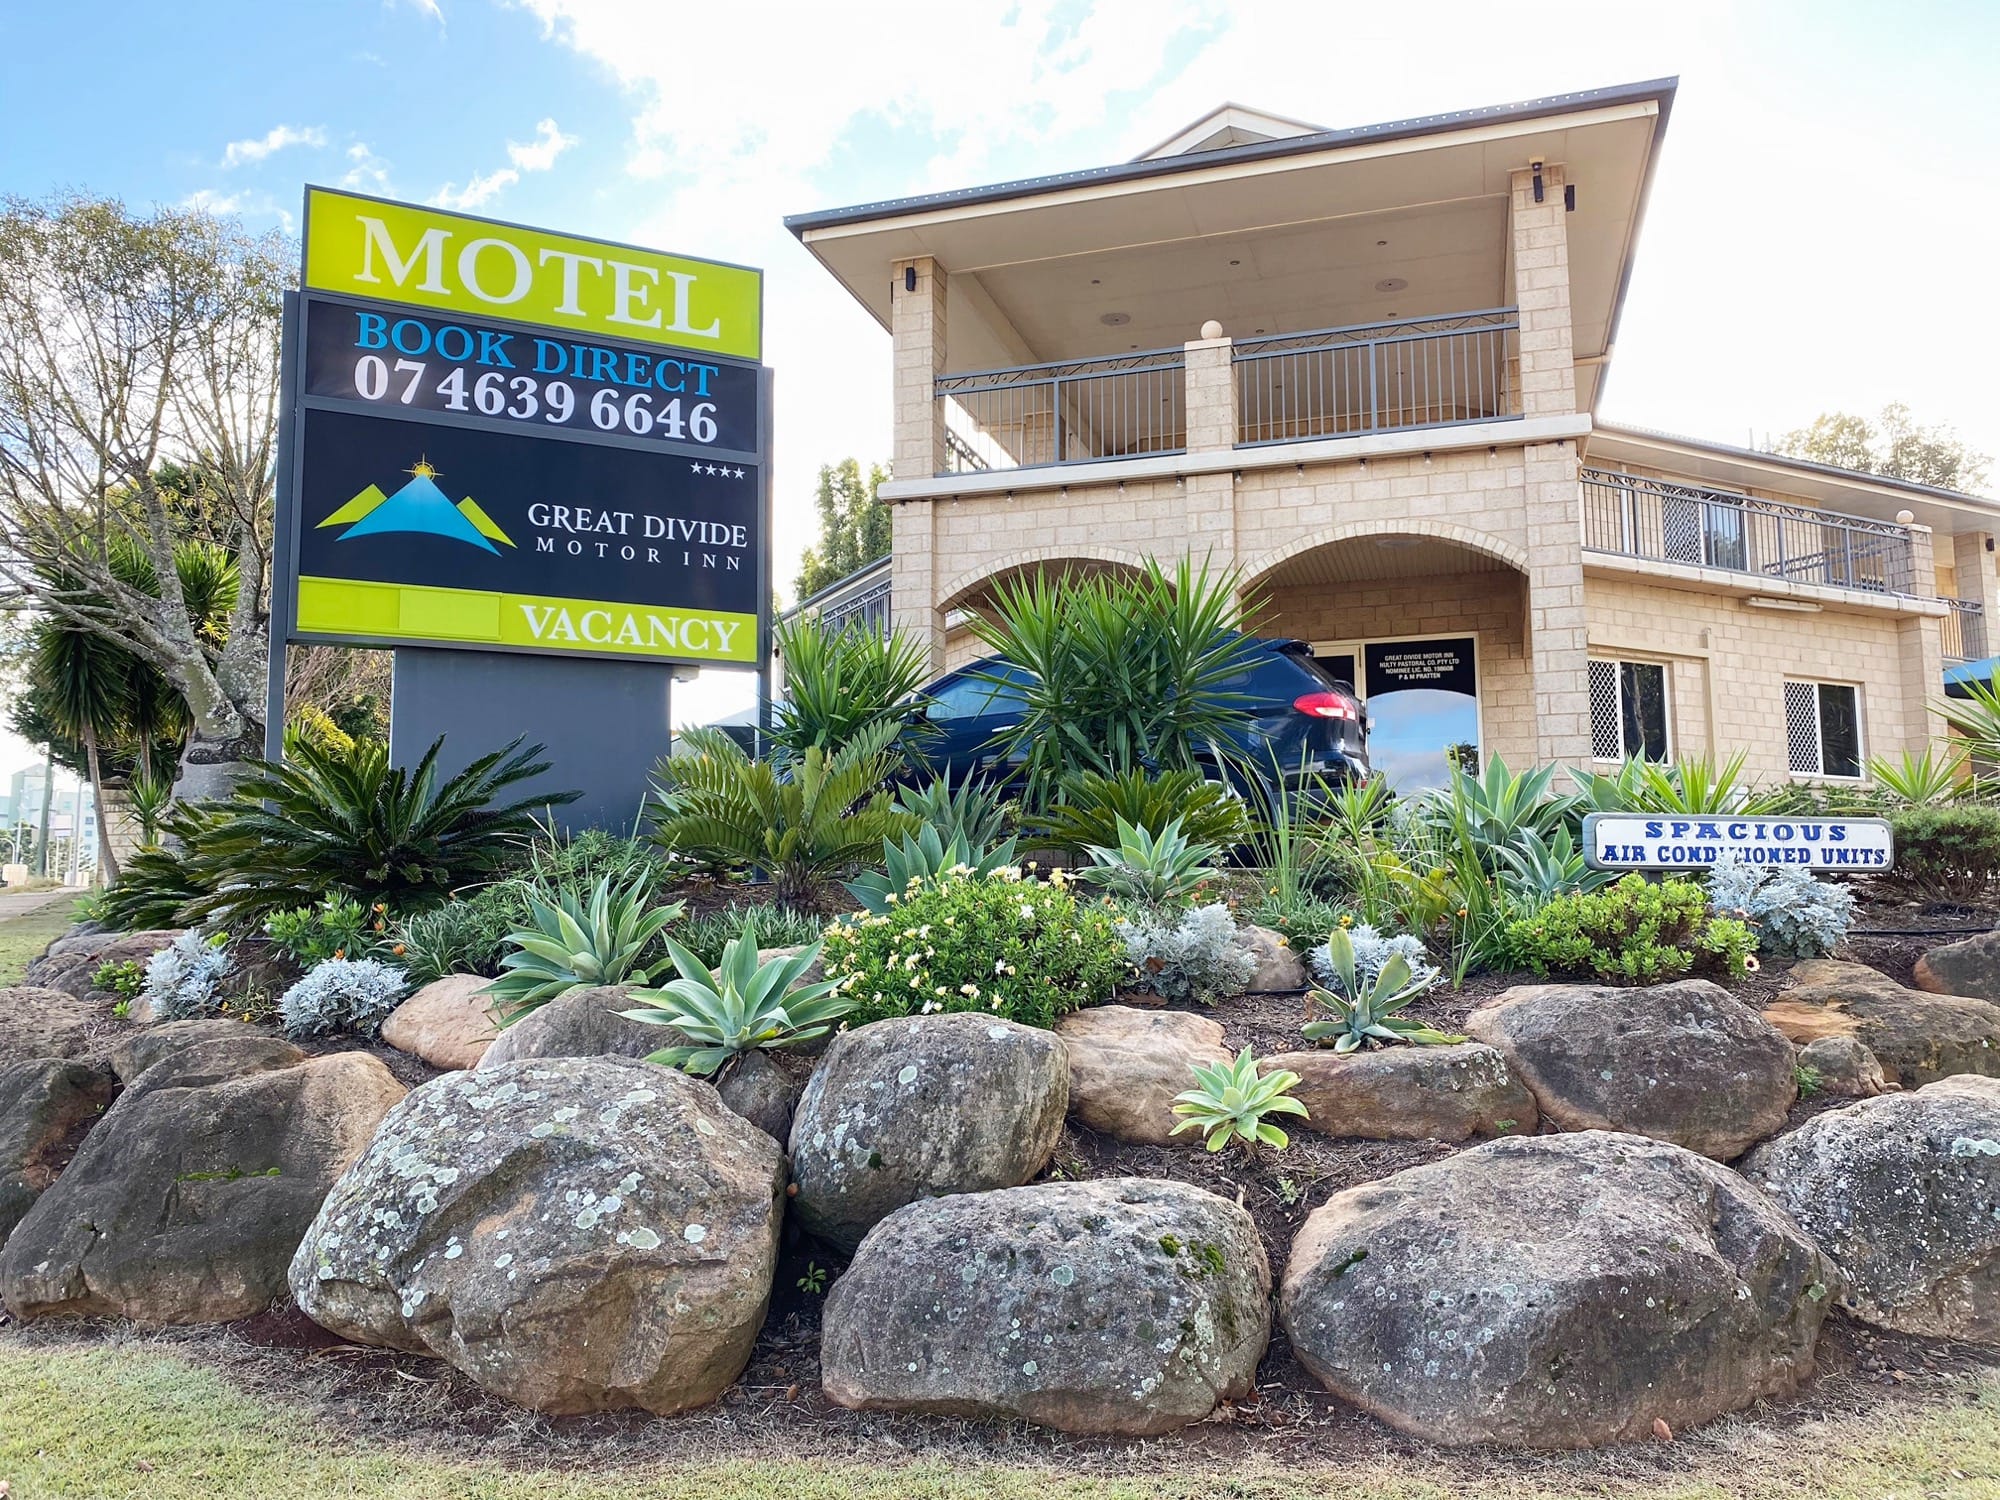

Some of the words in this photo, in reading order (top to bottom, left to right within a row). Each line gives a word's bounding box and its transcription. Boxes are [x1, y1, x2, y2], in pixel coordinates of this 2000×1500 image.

[353, 215, 720, 339] MOTEL
[354, 312, 515, 370] BOOK
[532, 338, 719, 398] DIRECT
[354, 354, 426, 404] 07
[436, 367, 575, 424] 4639
[589, 388, 718, 443] 6646
[528, 502, 634, 536] GREAT
[643, 515, 748, 549] DIVIDE
[536, 537, 661, 564] MOTOR
[683, 551, 741, 572] INN
[518, 605, 741, 654] VACANCY
[1601, 844, 1647, 862] AIR
[1657, 845, 1811, 865] CONDIONED
[1821, 847, 1885, 865] UNITS
[1645, 821, 1847, 842] SPACIOUS
